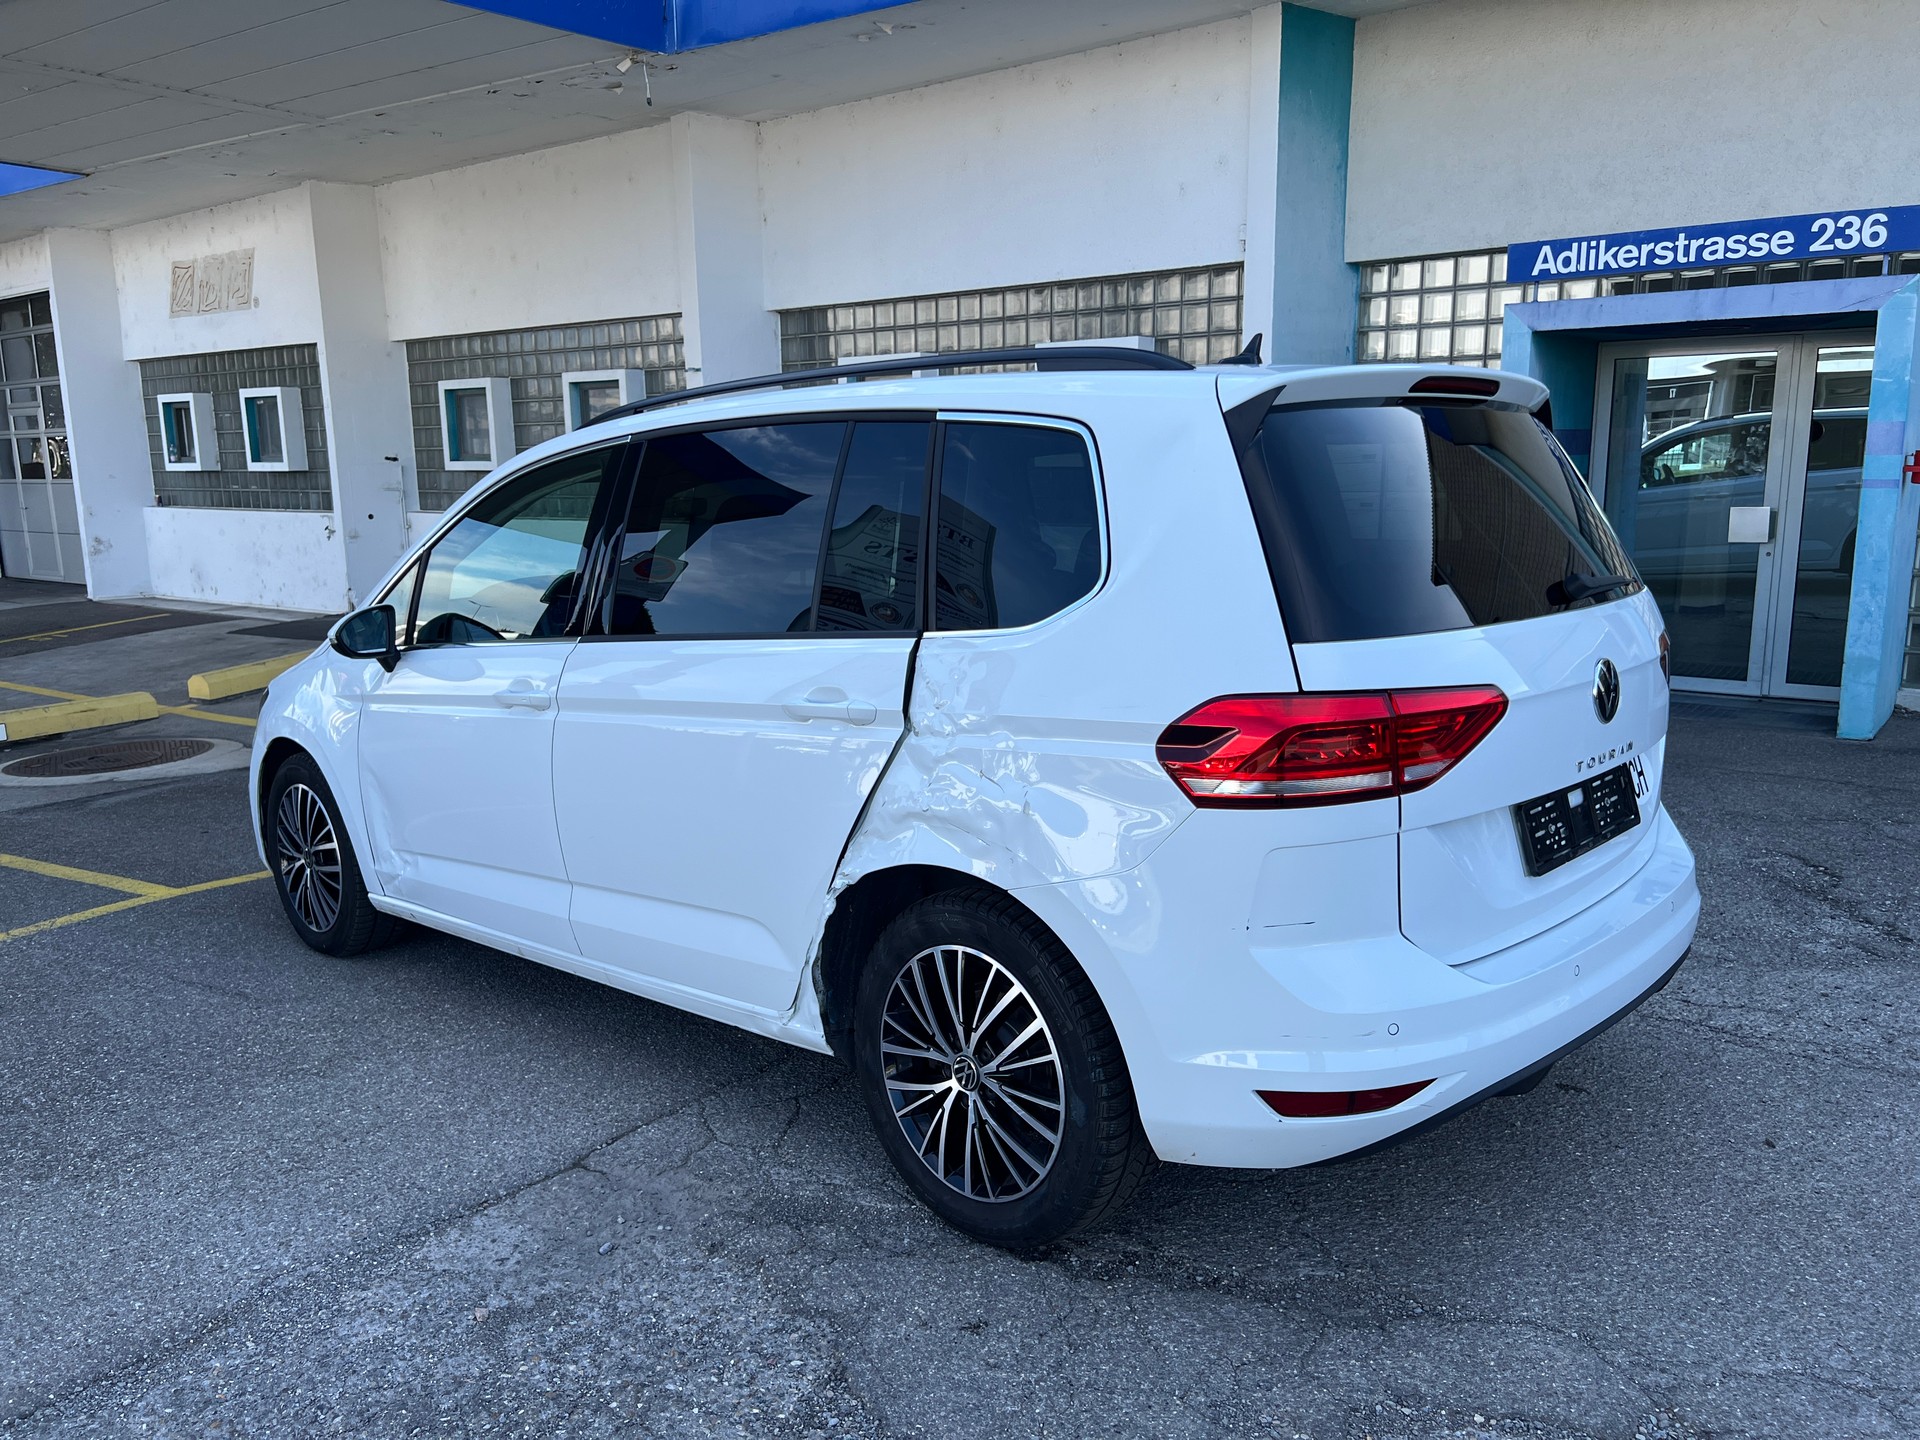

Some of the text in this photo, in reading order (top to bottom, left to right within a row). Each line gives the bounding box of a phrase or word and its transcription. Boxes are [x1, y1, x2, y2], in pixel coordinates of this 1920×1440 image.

[1531, 213, 1888, 276] Adlikerstrasse 236
[1575, 740, 1633, 774] TOURAN
[1628, 755, 1649, 799] CH
